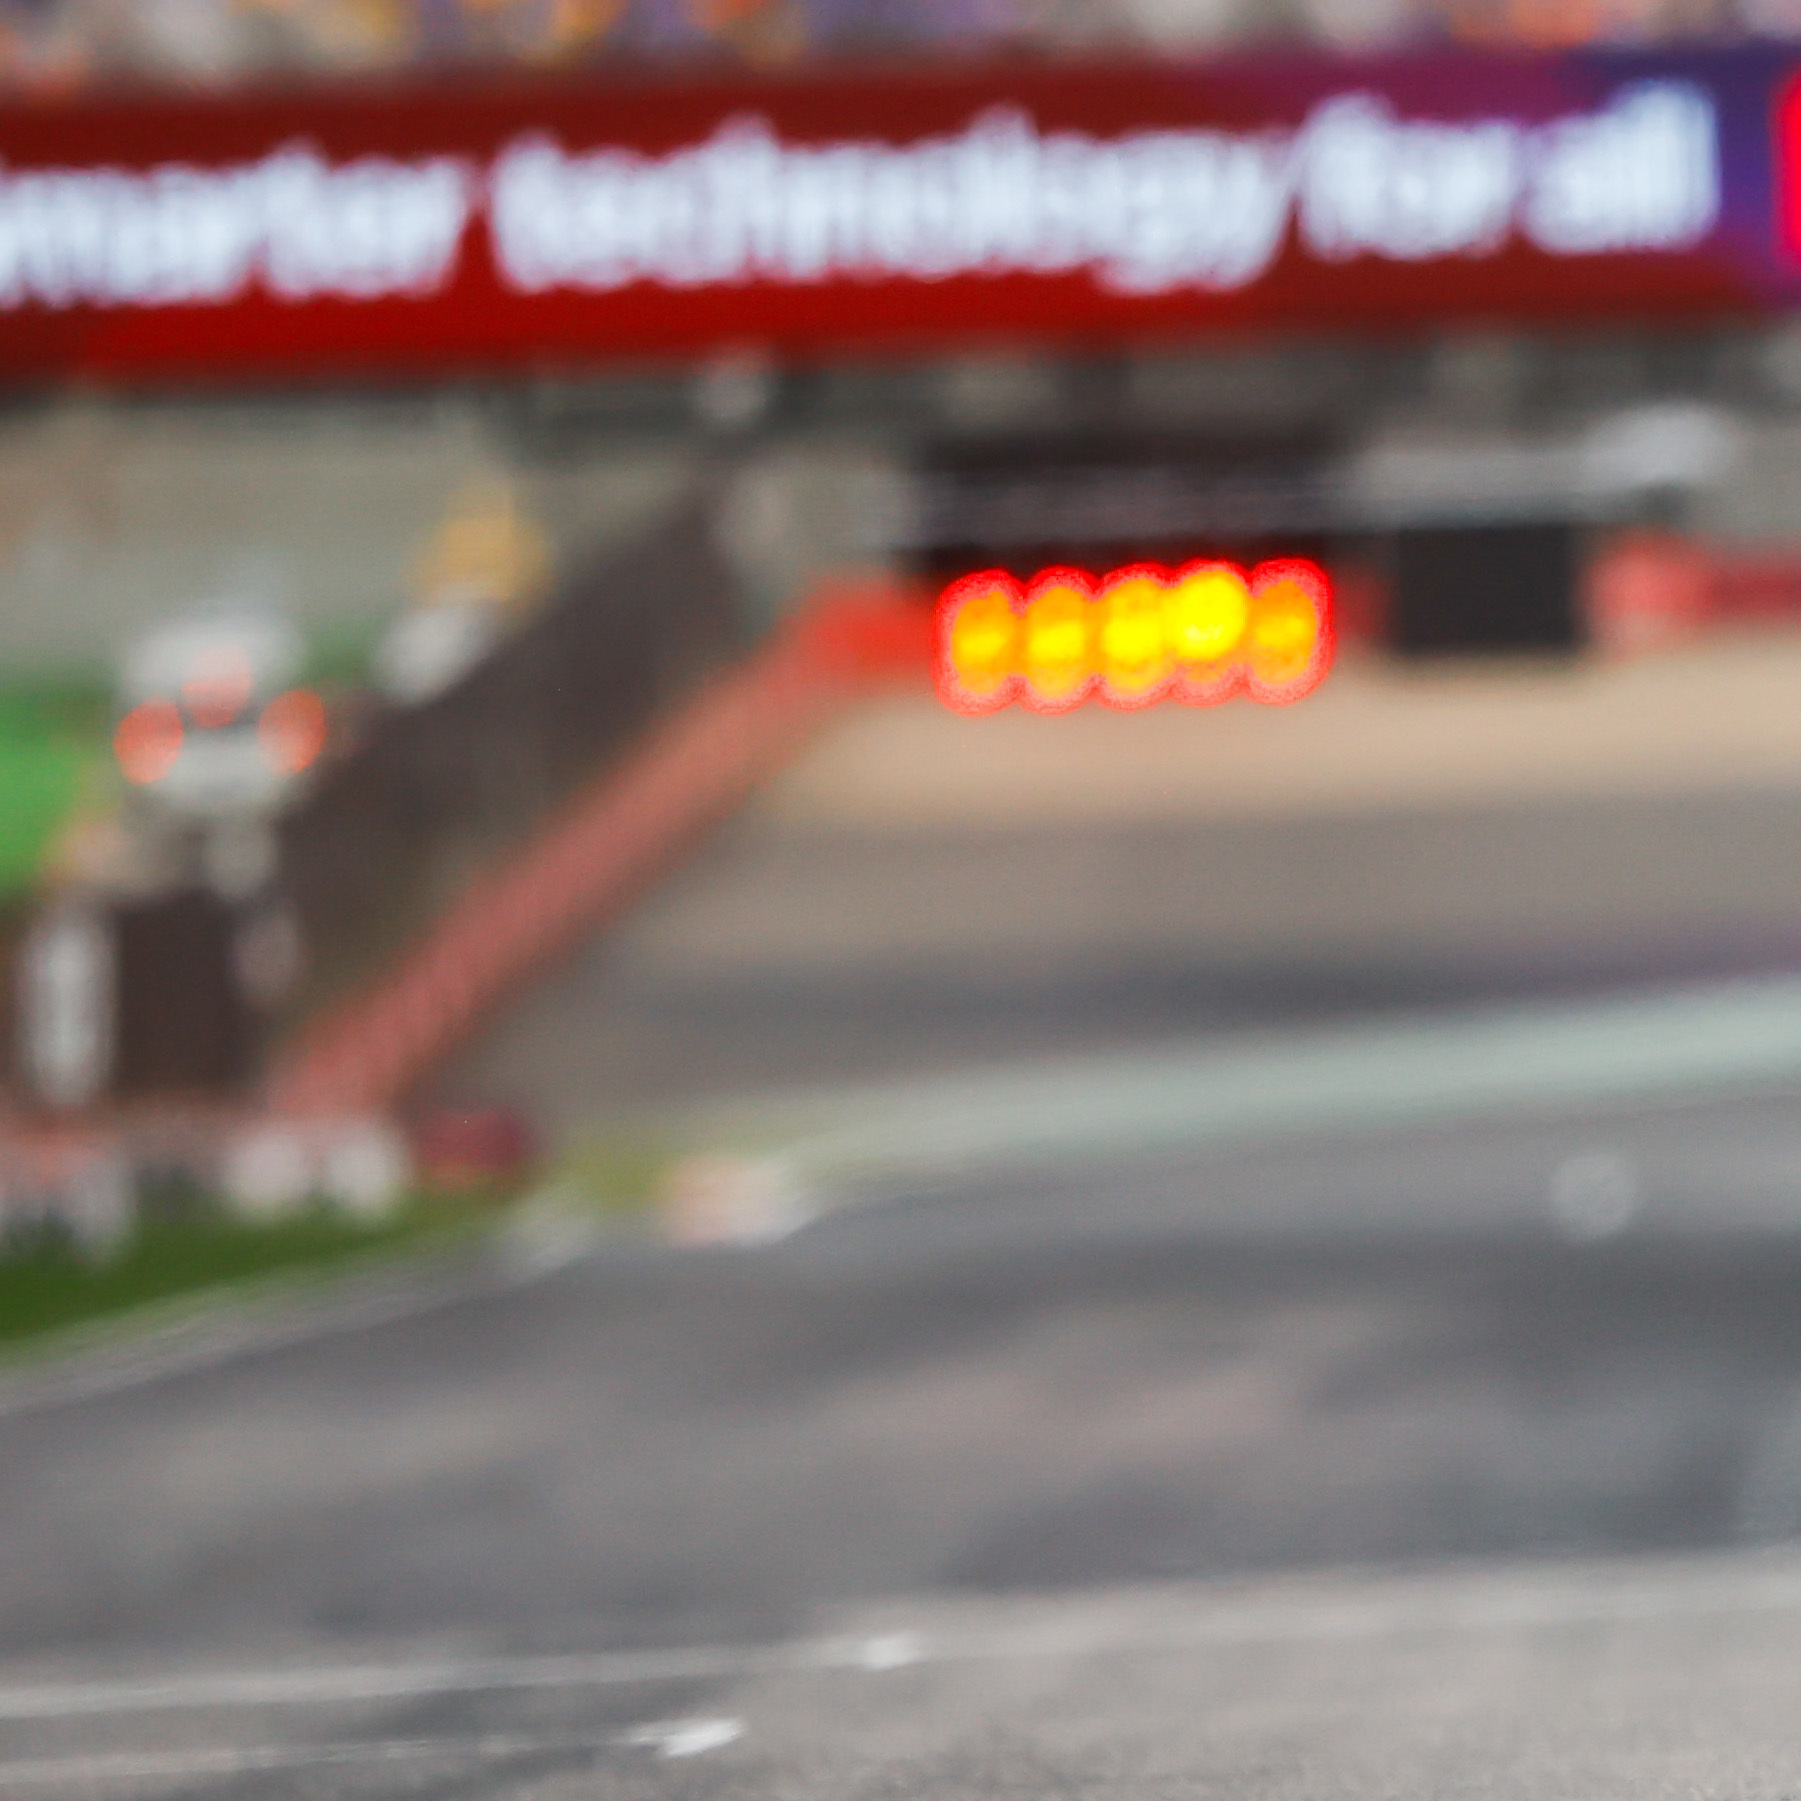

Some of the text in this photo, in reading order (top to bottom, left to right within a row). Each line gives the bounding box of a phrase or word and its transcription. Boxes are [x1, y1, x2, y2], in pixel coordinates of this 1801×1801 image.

[490, 116, 1293, 291] technology
[1295, 94, 1520, 260] for
[1522, 82, 1718, 252] all
